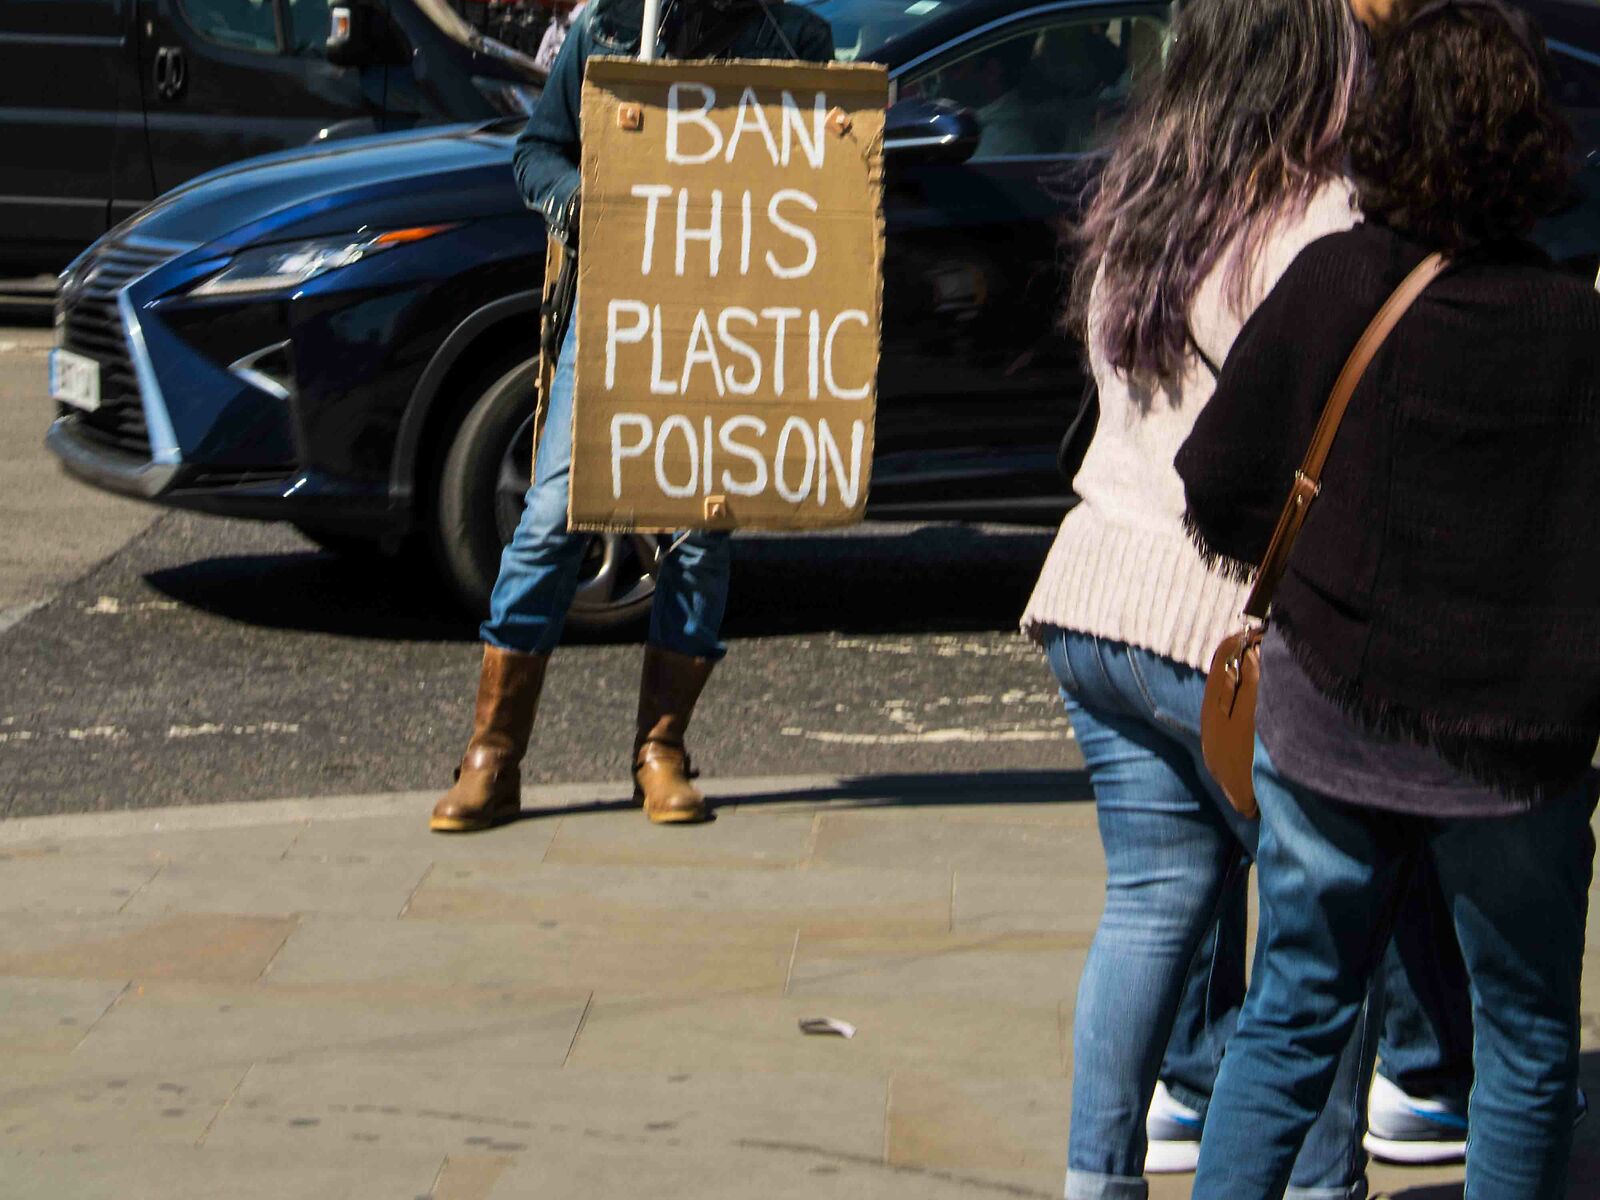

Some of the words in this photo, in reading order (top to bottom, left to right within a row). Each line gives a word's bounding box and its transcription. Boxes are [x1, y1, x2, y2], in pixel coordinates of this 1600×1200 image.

[665, 82, 827, 169] BAN
[631, 183, 818, 278] THIS
[605, 298, 871, 400] PLASTIC
[609, 412, 865, 509] POISON
